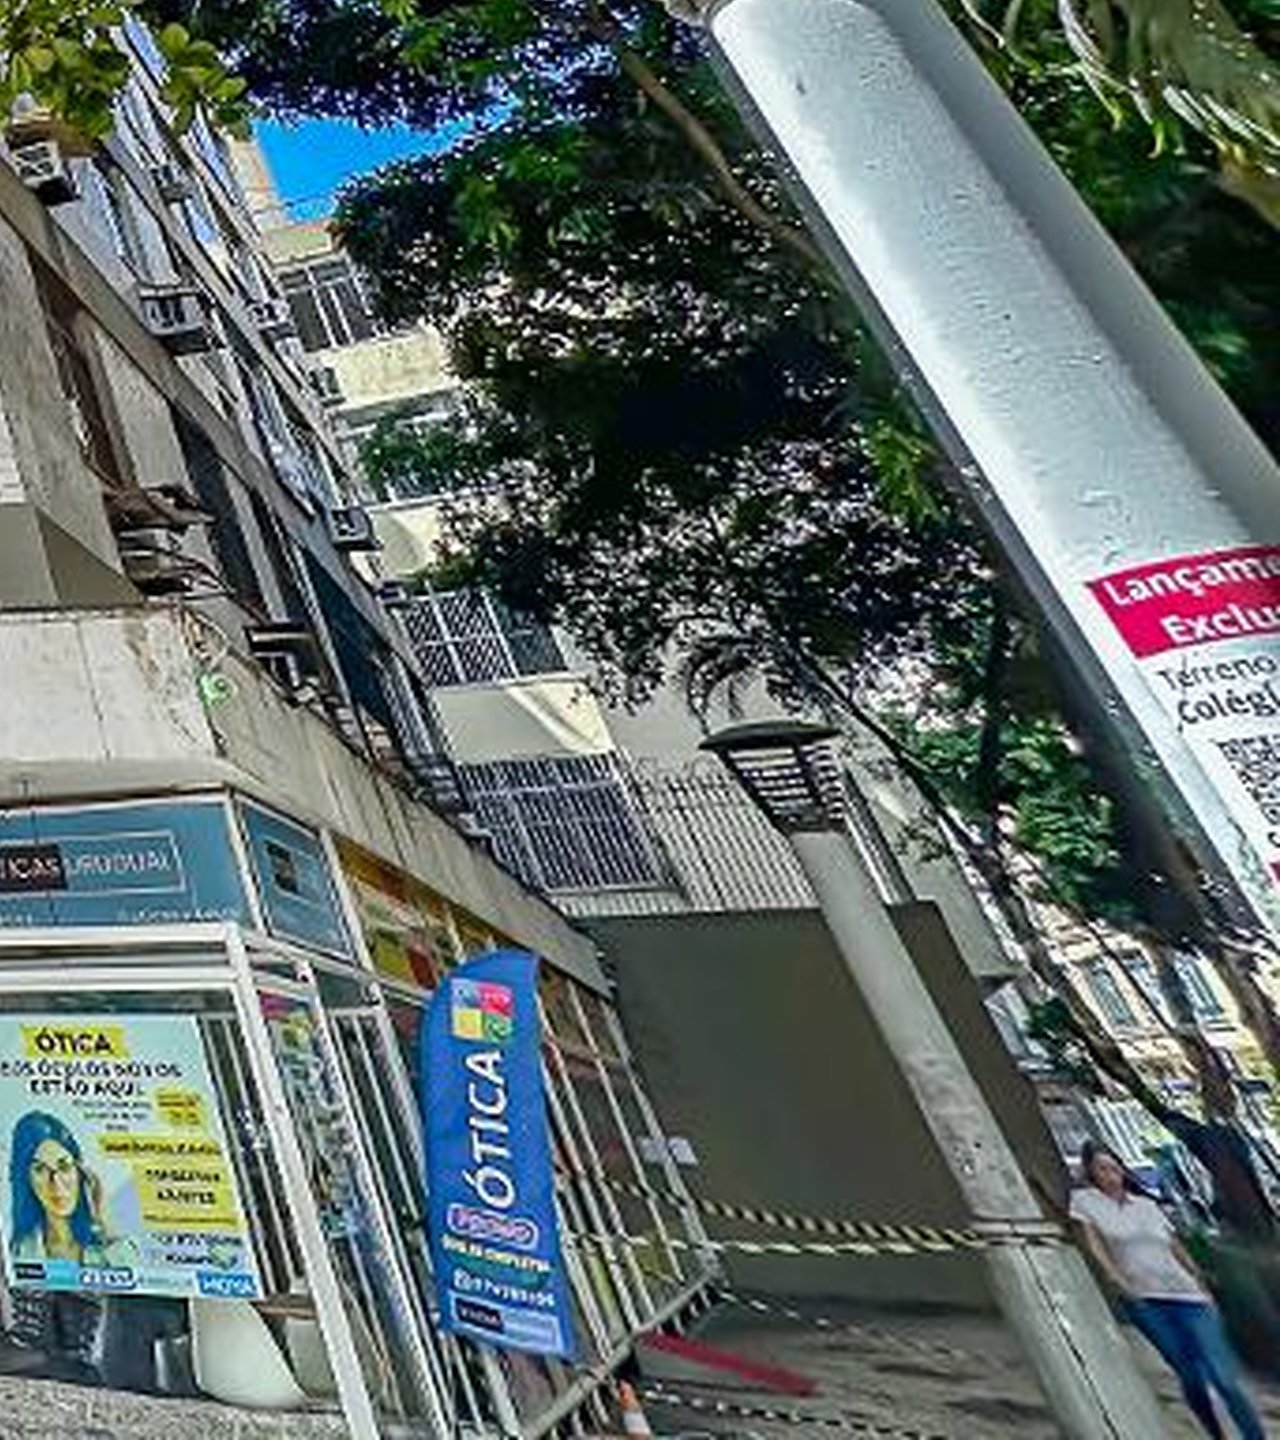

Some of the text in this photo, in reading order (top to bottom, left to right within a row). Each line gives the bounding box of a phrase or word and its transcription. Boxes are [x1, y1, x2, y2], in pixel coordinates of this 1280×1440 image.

[1159, 602, 1280, 644] Exclu
[1158, 655, 1278, 690] Terreno
[34, 1028, 112, 1054] ÓTICA
[461, 1048, 516, 1210] ÓTICA
